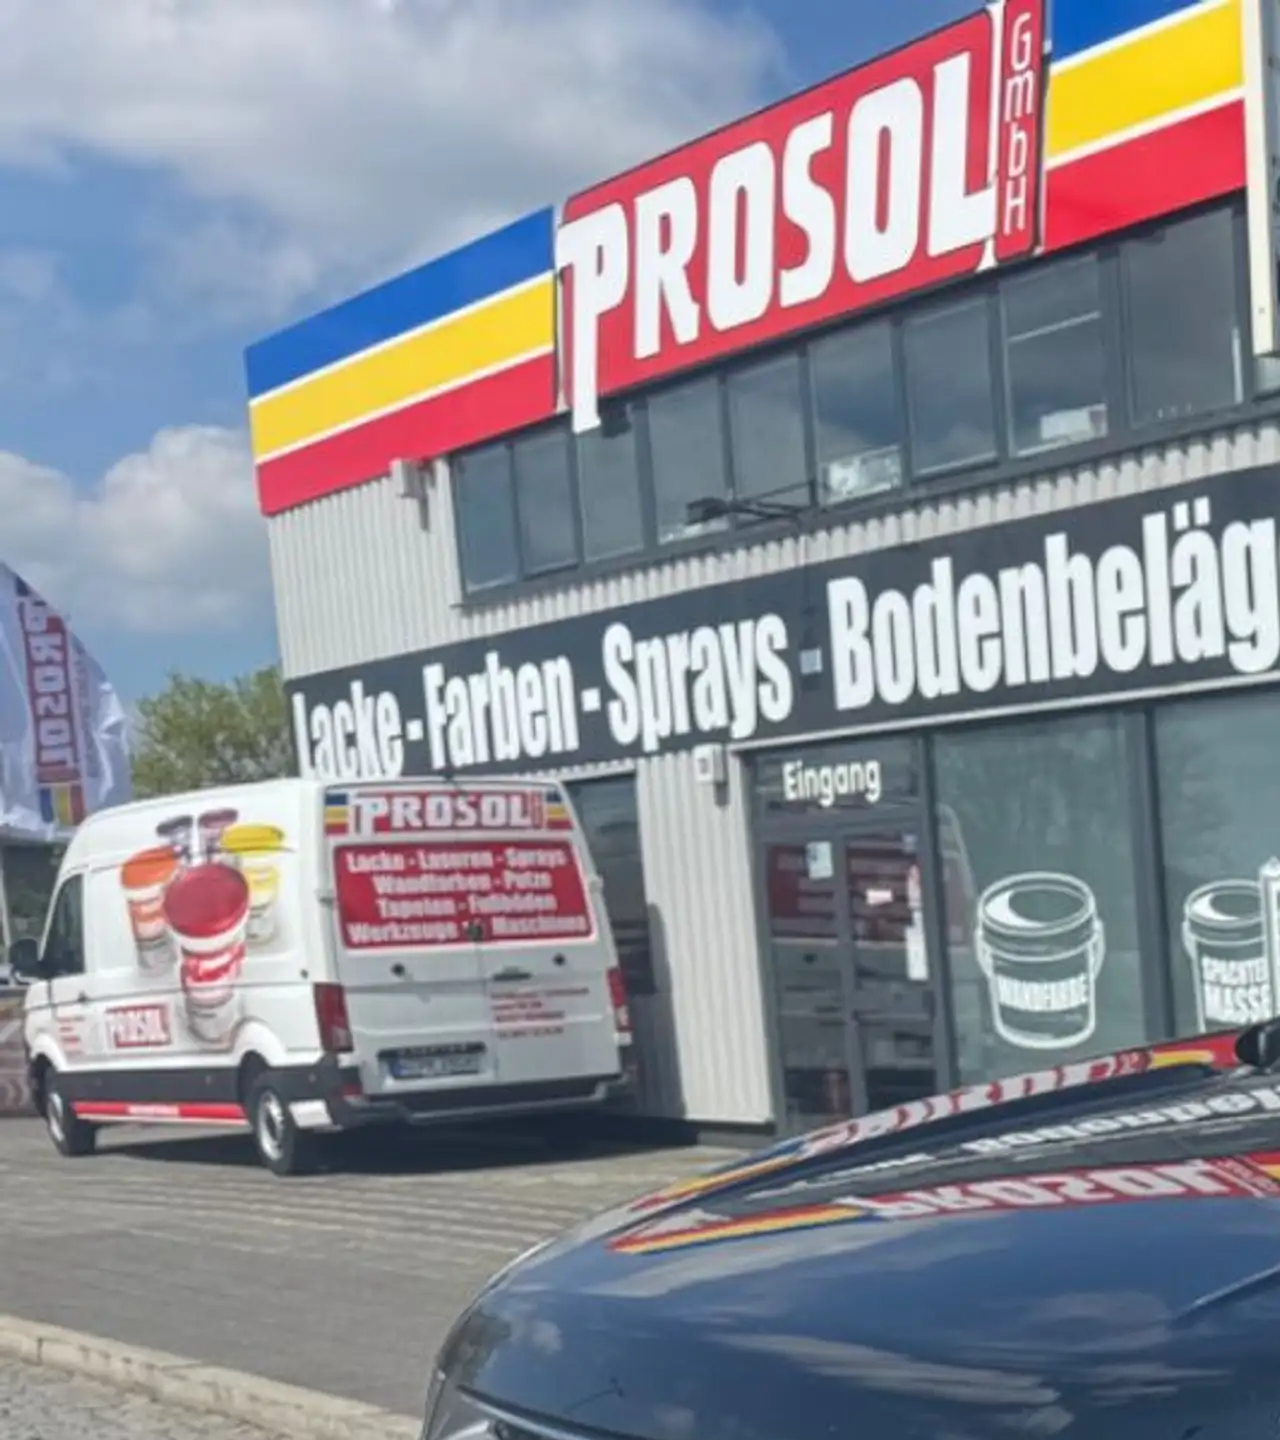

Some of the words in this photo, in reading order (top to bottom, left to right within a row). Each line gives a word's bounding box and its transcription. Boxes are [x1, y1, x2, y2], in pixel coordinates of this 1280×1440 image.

[1003, 12, 1034, 237] GmbH
[554, 50, 998, 433] PROSOL
[292, 680, 404, 778] Lacke
[422, 650, 580, 770] Farben
[602, 612, 793, 752] Sprays
[351, 792, 532, 836] PROSOL
[781, 758, 882, 807] Eingang
